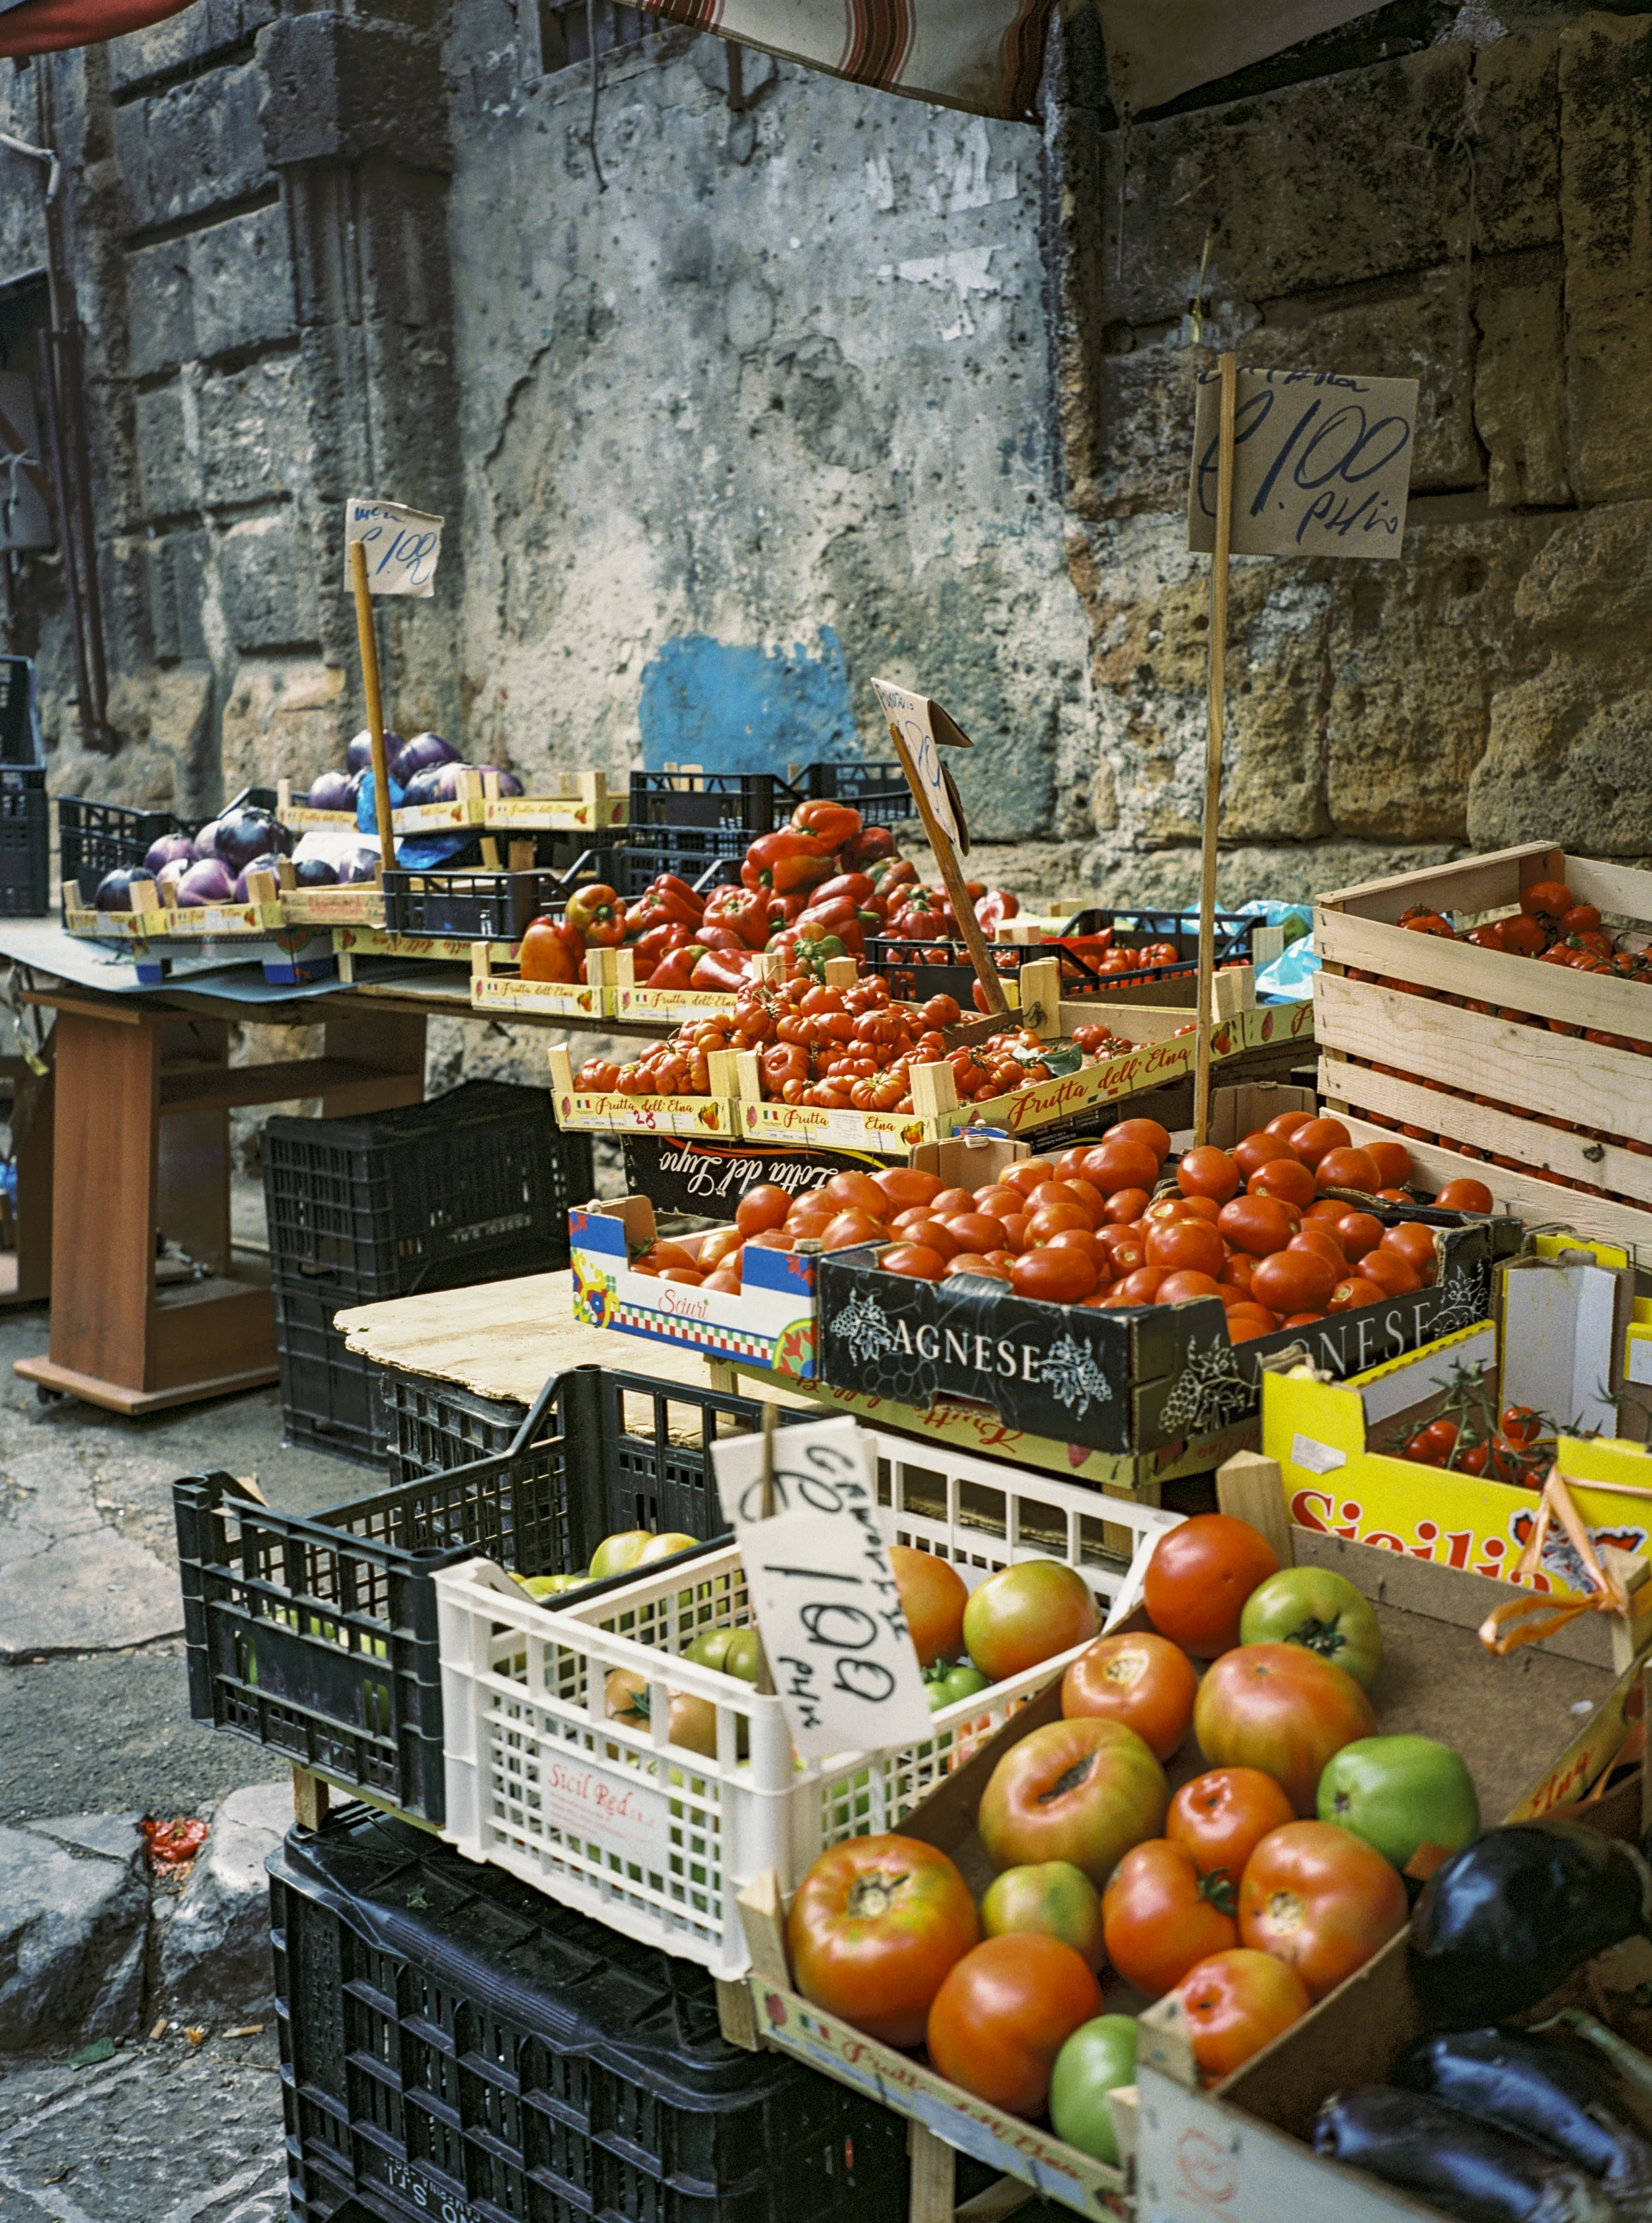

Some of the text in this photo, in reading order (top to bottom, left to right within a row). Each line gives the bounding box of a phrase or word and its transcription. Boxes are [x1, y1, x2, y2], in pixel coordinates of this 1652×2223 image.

[652, 991, 686, 1007] Frutta
[595, 1096, 635, 1115] Frutta
[783, 1108, 829, 1128] Frutta
[1009, 1076, 1088, 1128] Frutta
[659, 1141, 722, 1196] Lupo
[716, 1158, 763, 1194] del
[658, 1289, 710, 1321] Sciuri
[892, 1319, 1041, 1384] AGNESE
[548, 1763, 593, 1799] Sicil
